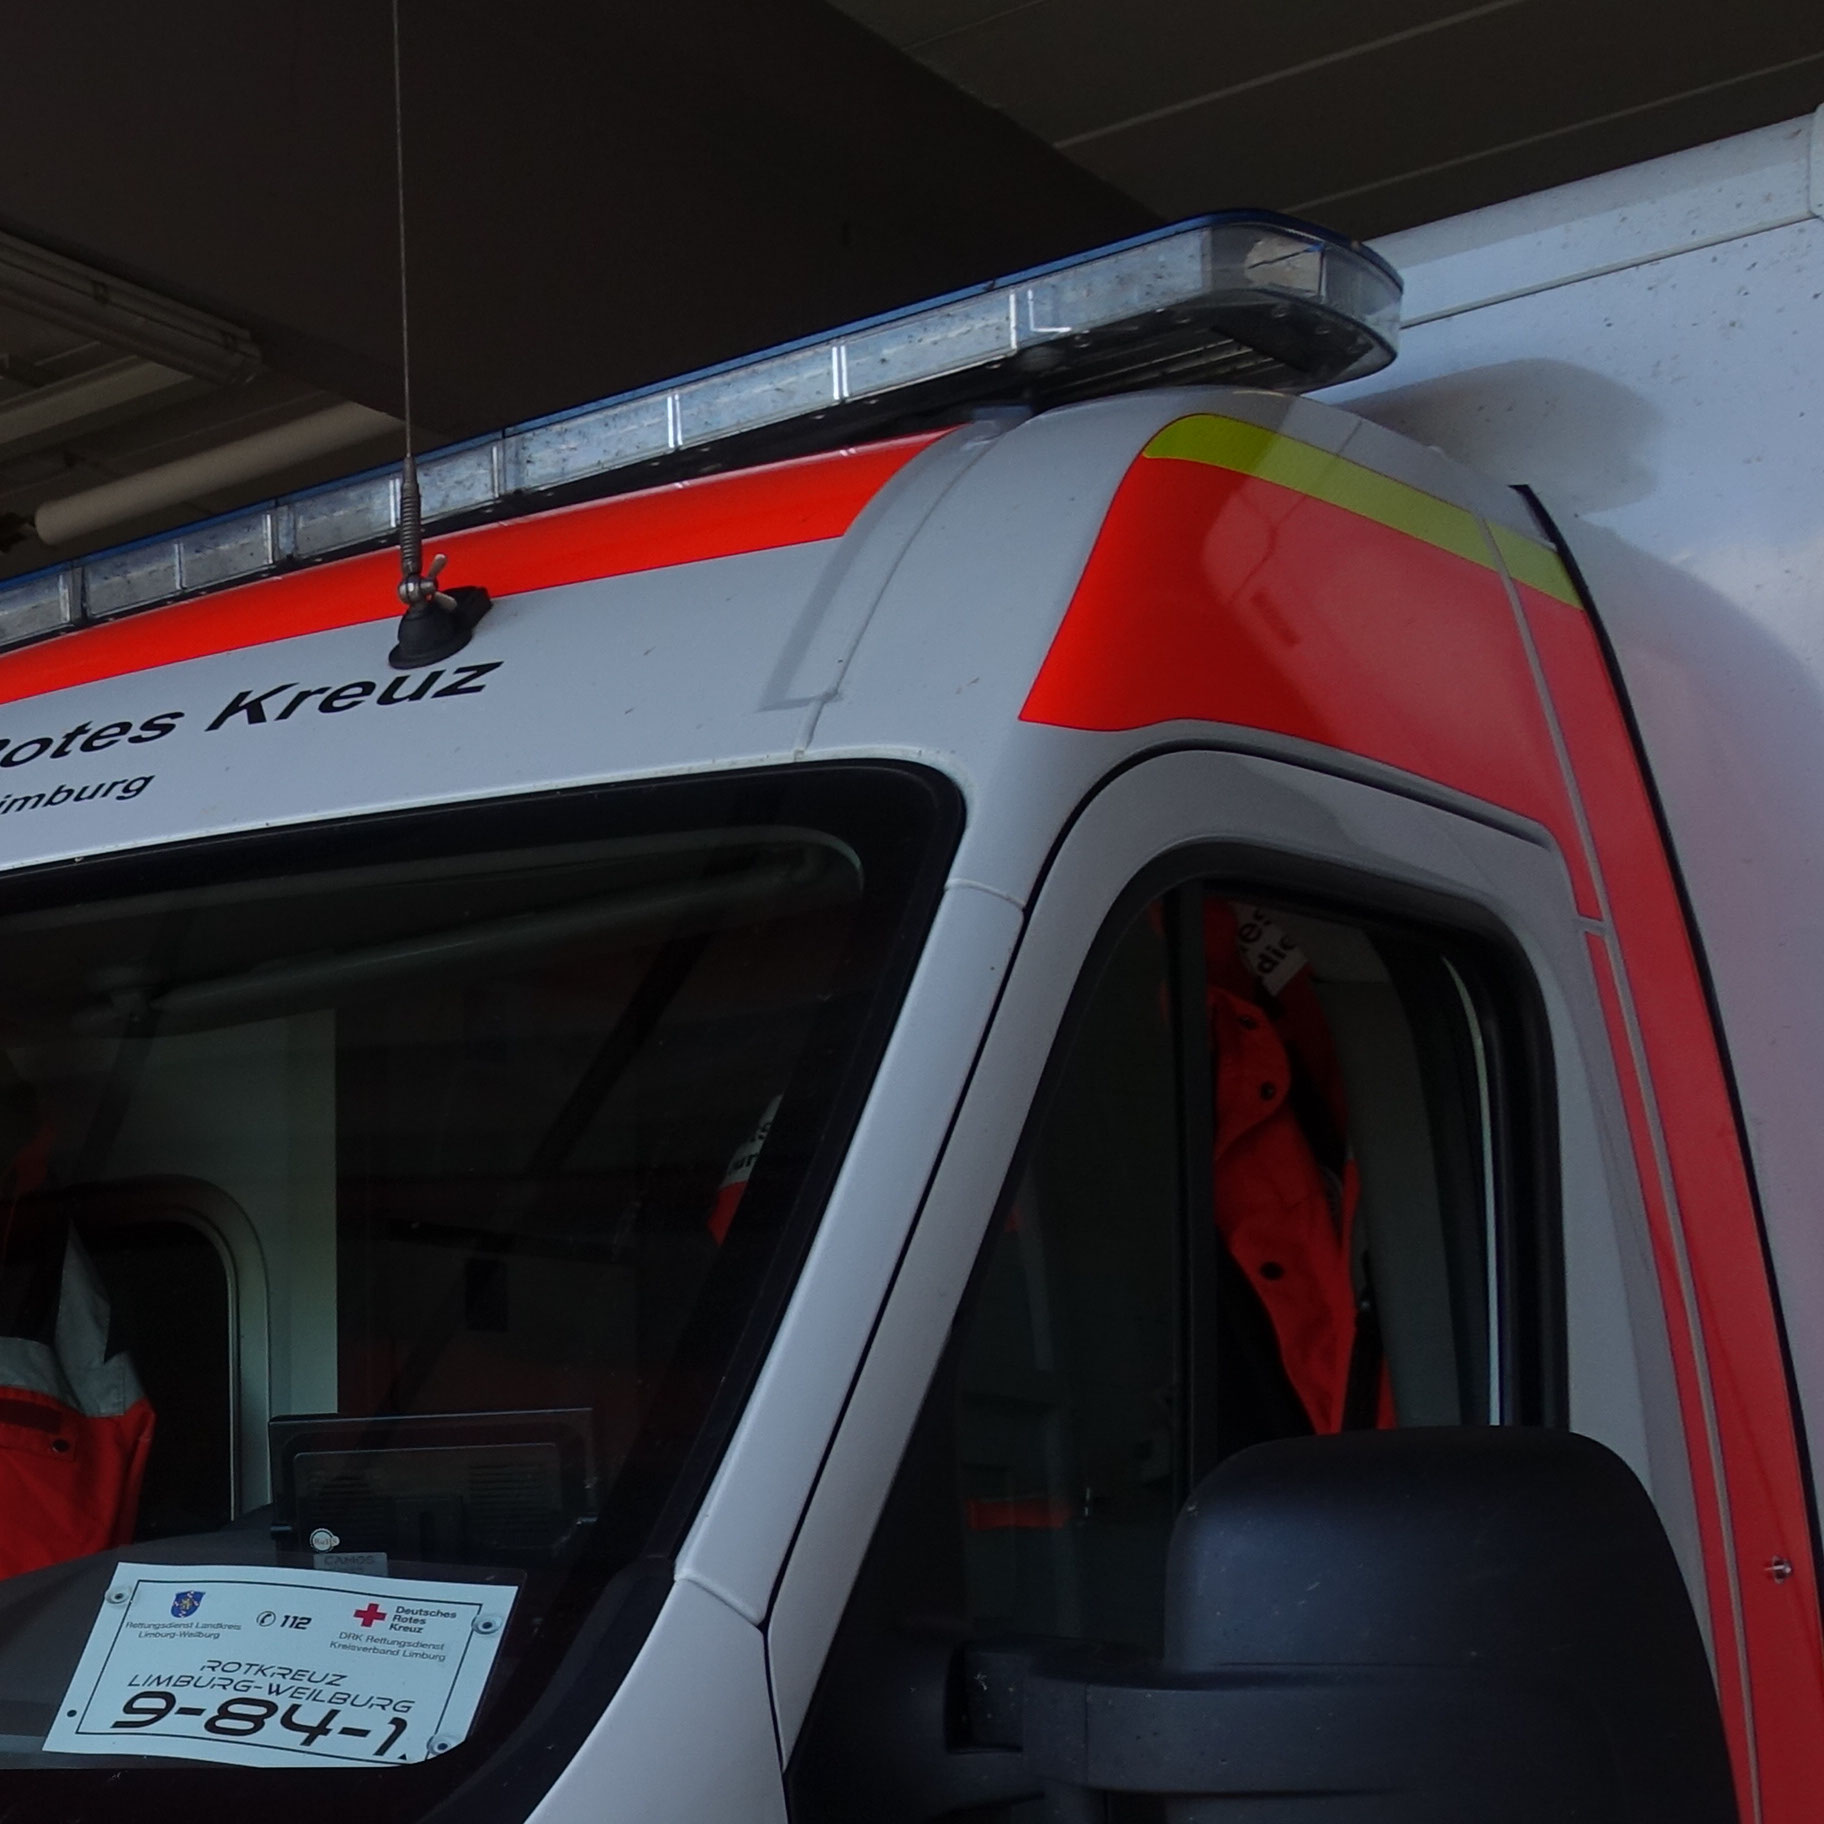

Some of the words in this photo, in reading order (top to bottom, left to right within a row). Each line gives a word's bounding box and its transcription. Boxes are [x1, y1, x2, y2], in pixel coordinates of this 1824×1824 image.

[205, 659, 505, 732] Kreuz
[392, 1615, 426, 1625] Rotes
[395, 1606, 457, 1619] Deutsches
[280, 1615, 312, 1630] 112
[389, 1623, 424, 1634] Kreuz
[402, 1650, 446, 1662] Limburg
[200, 1659, 347, 1687] ROTKREUZ
[127, 1674, 415, 1714] LIMBURG-WEILBURG
[110, 1690, 408, 1757] 9-84-1
